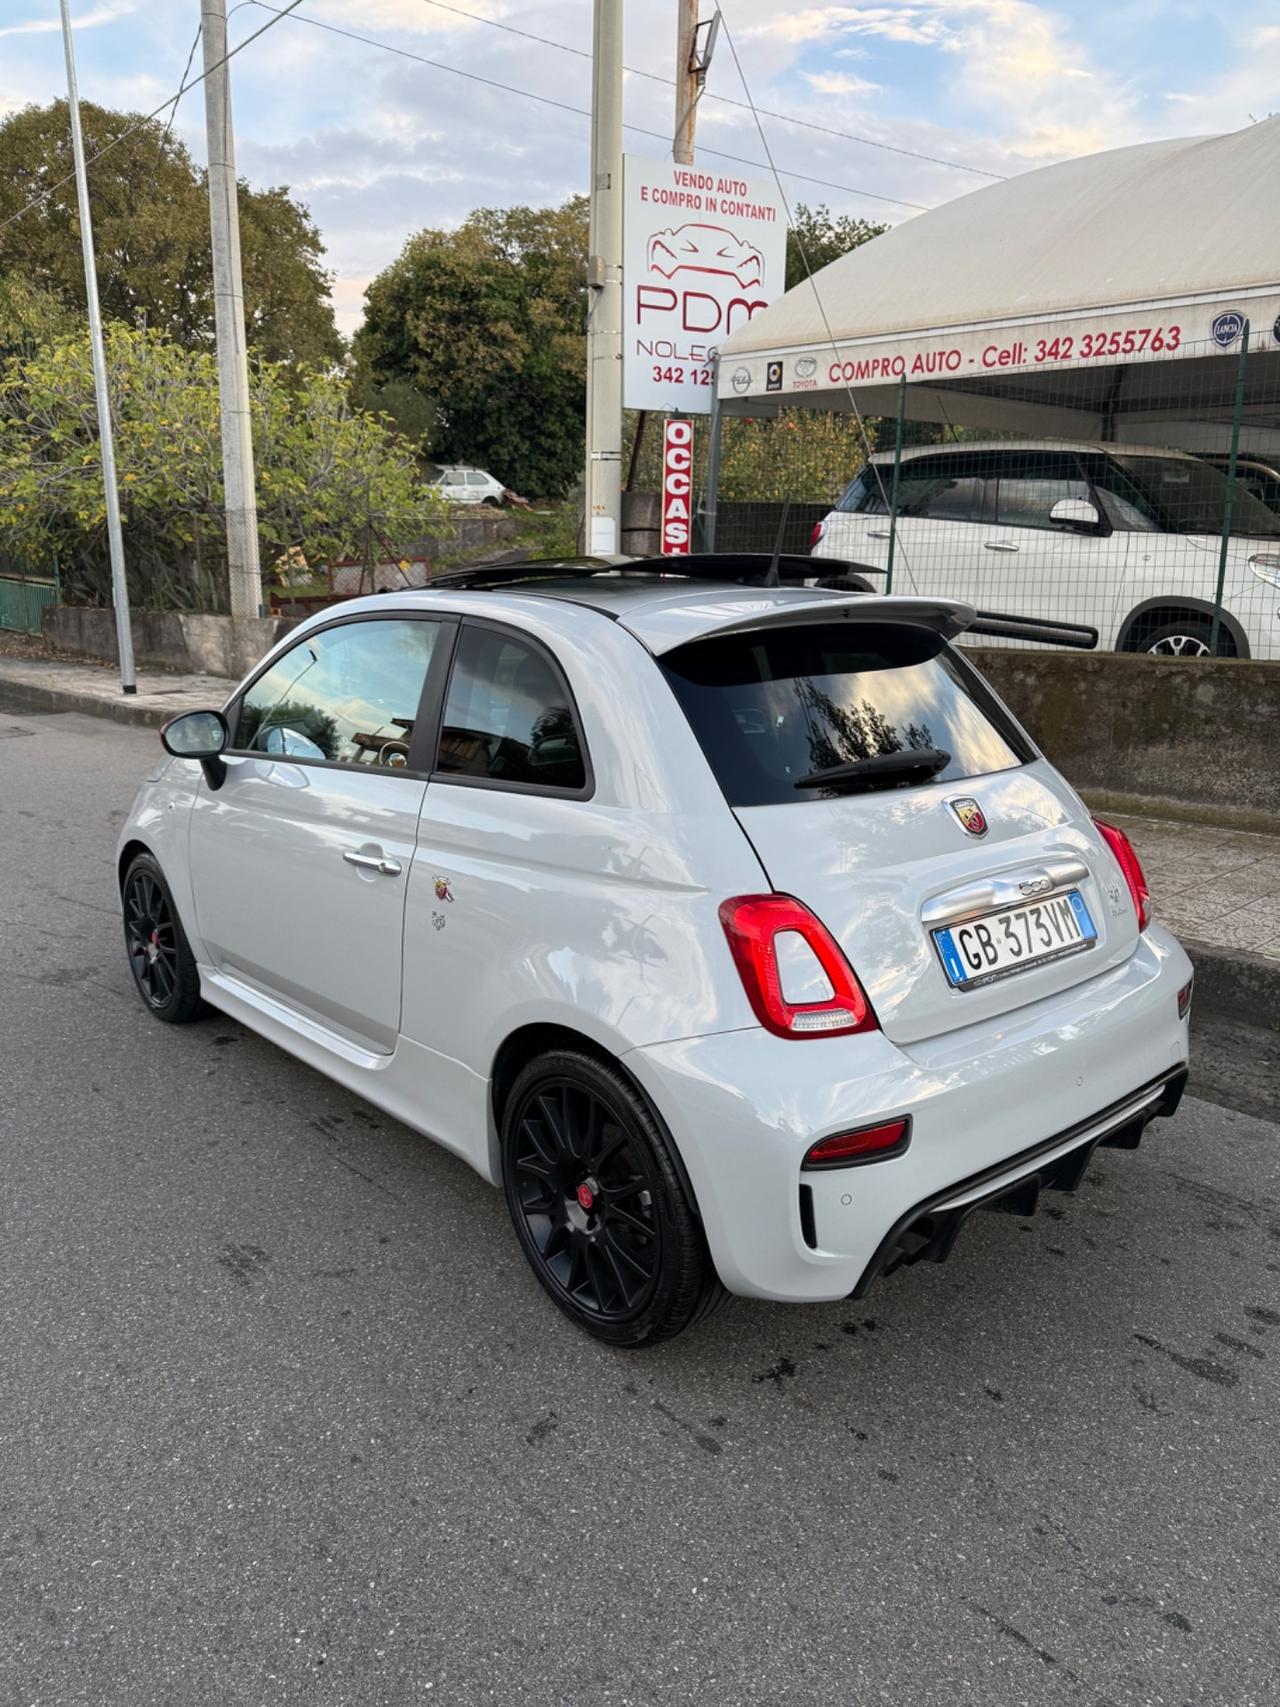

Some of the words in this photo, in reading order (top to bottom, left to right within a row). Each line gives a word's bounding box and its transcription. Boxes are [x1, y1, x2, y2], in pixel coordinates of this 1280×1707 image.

[674, 170, 713, 192] VENDO
[717, 178, 747, 197] AUTO
[641, 186, 649, 201] E
[652, 188, 701, 210] COMPRO
[705, 196, 717, 212] IN
[720, 198, 776, 222] CONTANTI
[829, 355, 906, 382] COMPRO
[911, 349, 961, 374] AUTO
[982, 342, 1027, 367] Cell:
[1034, 336, 1074, 363] 342
[1079, 325, 1181, 358] 3255763
[652, 366, 684, 384] 342
[792, 379, 817, 389] TOYOTA
[1018, 879, 1050, 896] 500
